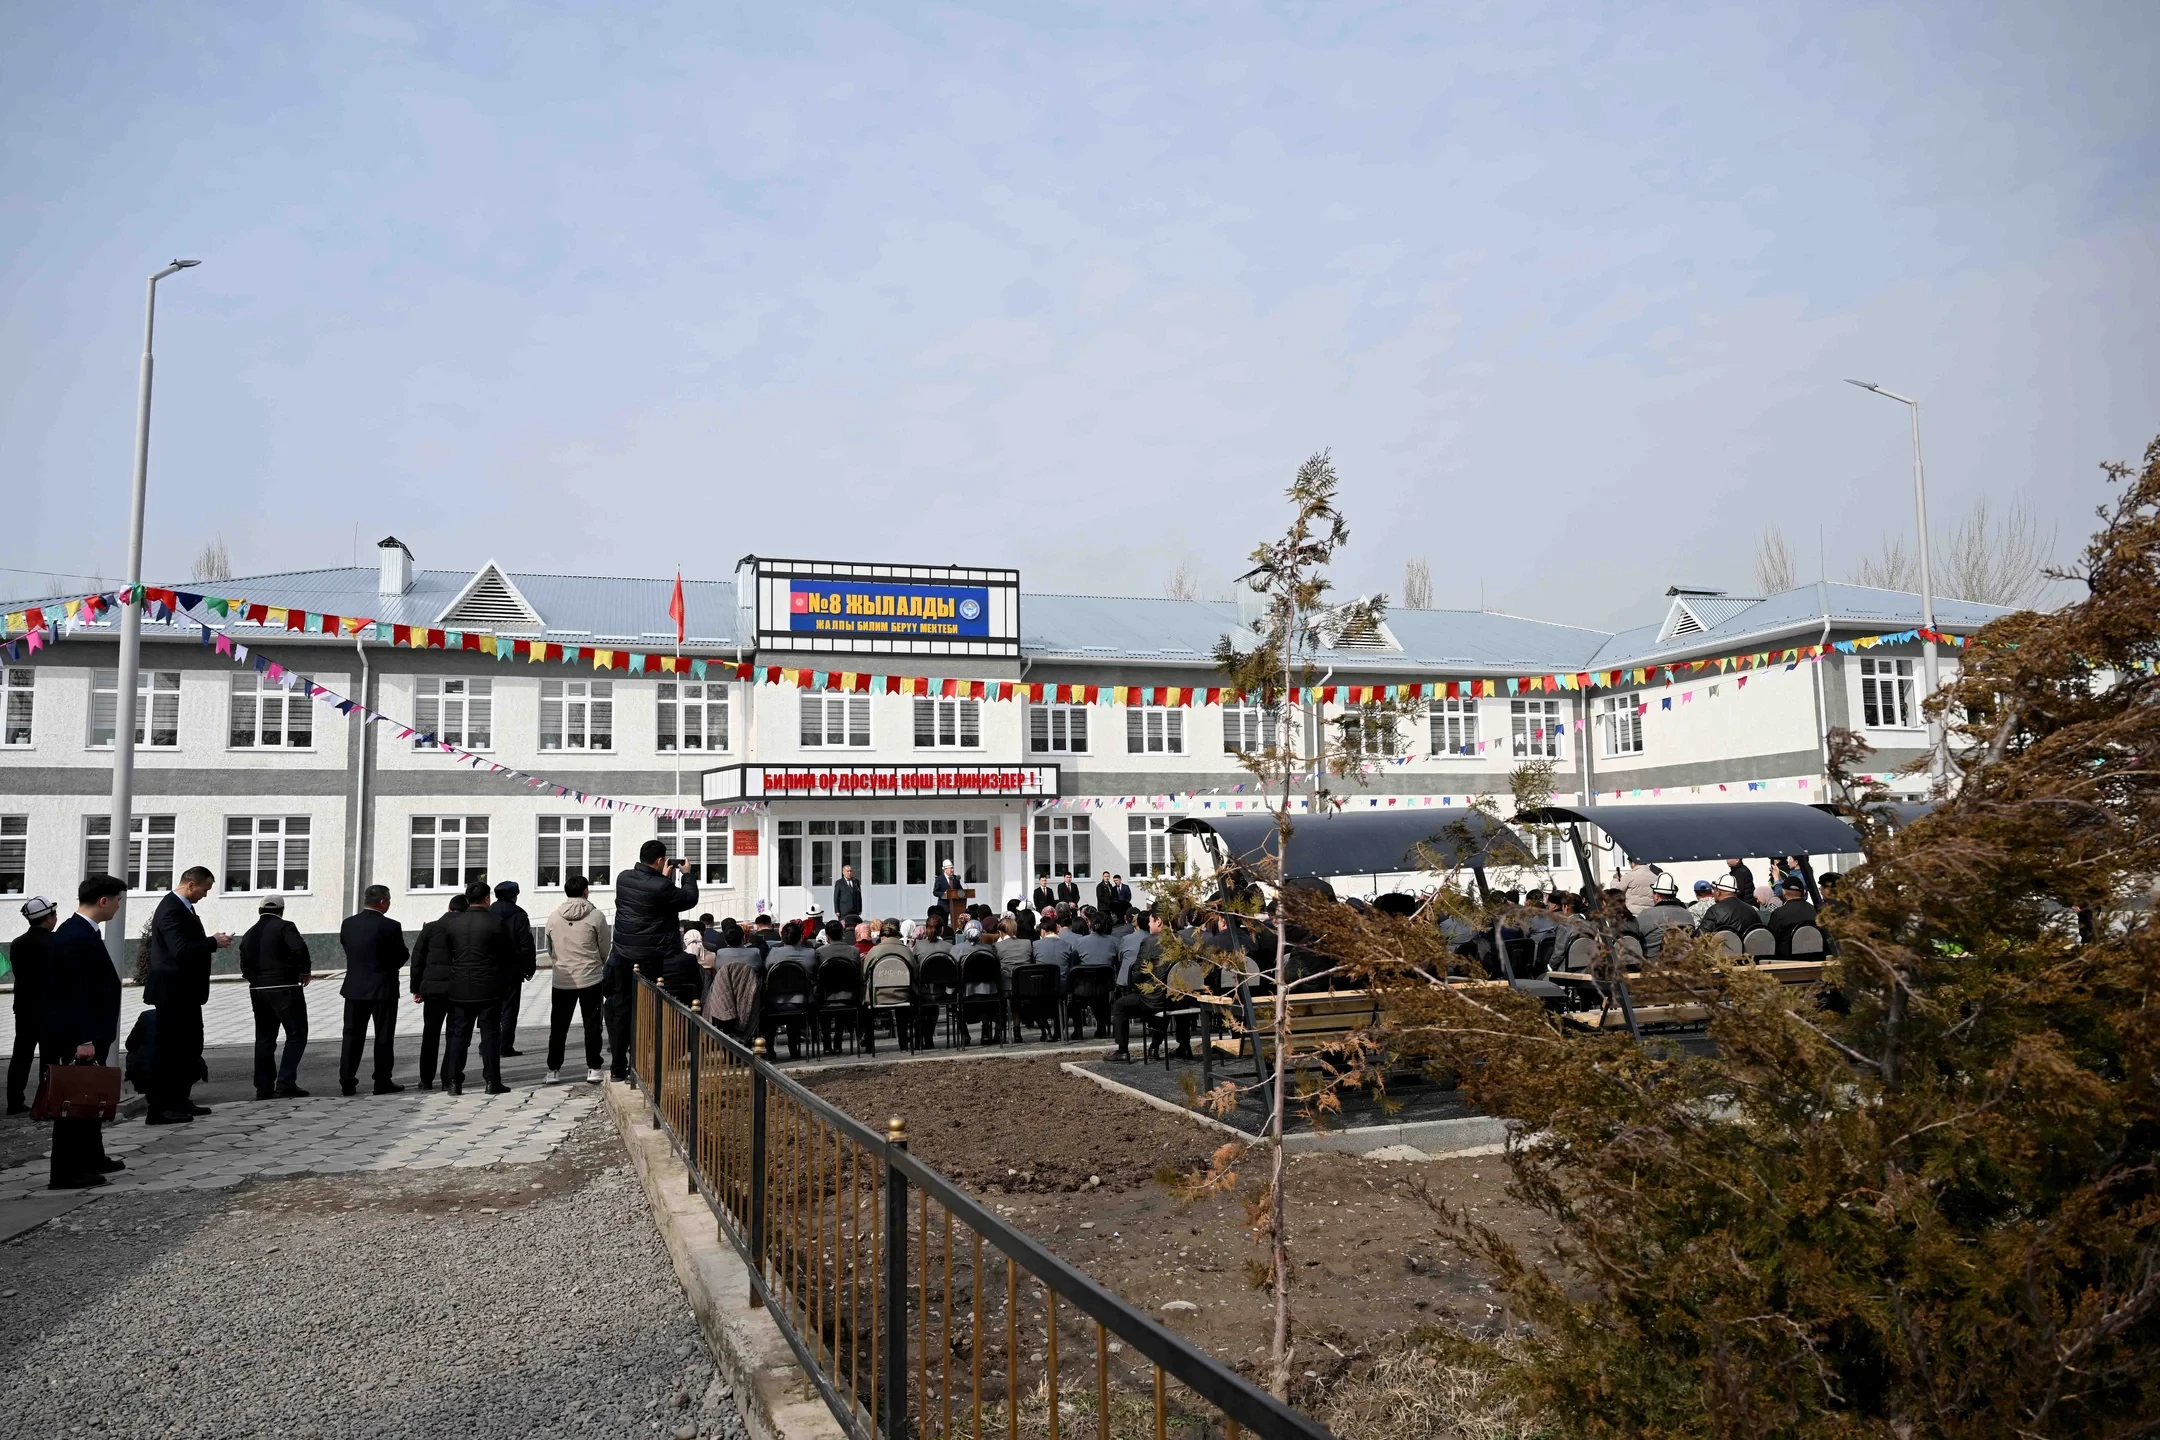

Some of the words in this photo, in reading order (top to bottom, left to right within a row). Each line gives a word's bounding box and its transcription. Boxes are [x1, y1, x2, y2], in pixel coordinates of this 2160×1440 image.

[808, 593, 841, 615] №8
[846, 594, 954, 620] ЖЫЛАЛДЫ
[816, 620, 854, 631] ЖАЛПЫ
[857, 621, 888, 632] БИЛИМ
[891, 622, 917, 633] БЕРҮҮ
[920, 623, 958, 634] МЕКТЕБИ
[763, 773, 816, 790] БИЛИМ
[818, 774, 898, 791] ОРДОСУНА
[901, 774, 934, 788] КОШ
